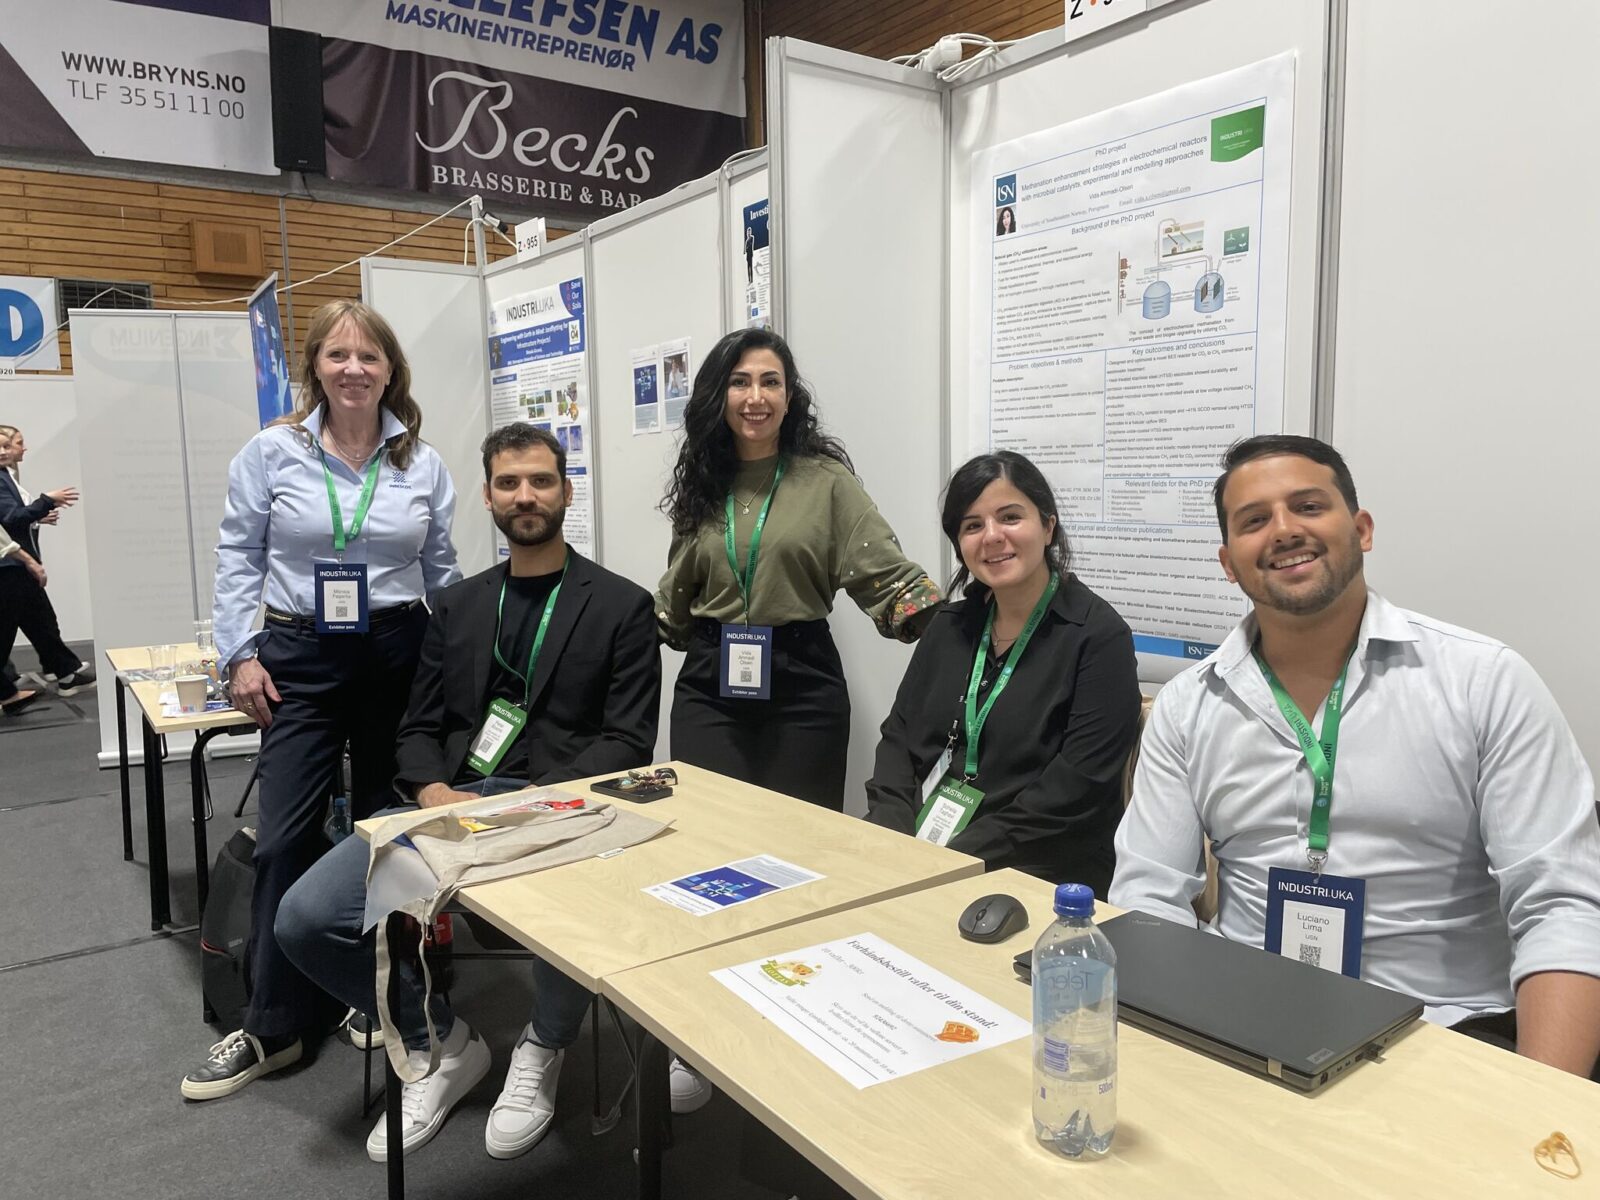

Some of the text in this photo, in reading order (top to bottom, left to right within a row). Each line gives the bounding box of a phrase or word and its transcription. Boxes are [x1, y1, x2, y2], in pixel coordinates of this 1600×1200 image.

[385, 1, 636, 72] MASKINENTREPRENØR
[666, 17, 723, 65] AS
[61, 51, 245, 93] WWW.BRYNS.NO
[67, 79, 244, 119] TLF 35 51 11 00
[415, 70, 655, 184] Becks
[1021, 133, 1207, 191] Methanation enhancement strategies in electrochemical reactors
[1095, 142, 1125, 156] PhD project
[432, 164, 642, 209] BRASSERIE & BAR
[1021, 193, 1031, 202] with
[1033, 186, 1055, 199] microbial
[1082, 169, 1118, 188] experimental
[1121, 166, 1131, 176] and
[1133, 158, 1162, 175] modelling
[1164, 147, 1204, 166] approaches
[1071, 221, 1102, 236] Background
[1110, 217, 1119, 225] the
[1121, 214, 1132, 223] PhD
[1134, 209, 1154, 222] project
[527, 235, 538, 250] 955
[1138, 327, 1154, 335] concept
[1162, 321, 1194, 331] electrochemical
[1030, 358, 1054, 368] objectives
[1061, 355, 1083, 364] methods
[1132, 338, 1225, 357] Key outcomes and conclusions
[1077, 524, 1094, 532] journal
[1139, 525, 1172, 534] publications
[1297, 912, 1330, 925] Luciano
[1302, 922, 1322, 933] Lima
[905, 975, 939, 992] vafler
[931, 991, 952, 1000] til
[943, 998, 968, 1010] din
[960, 1007, 1000, 1028] stand!
